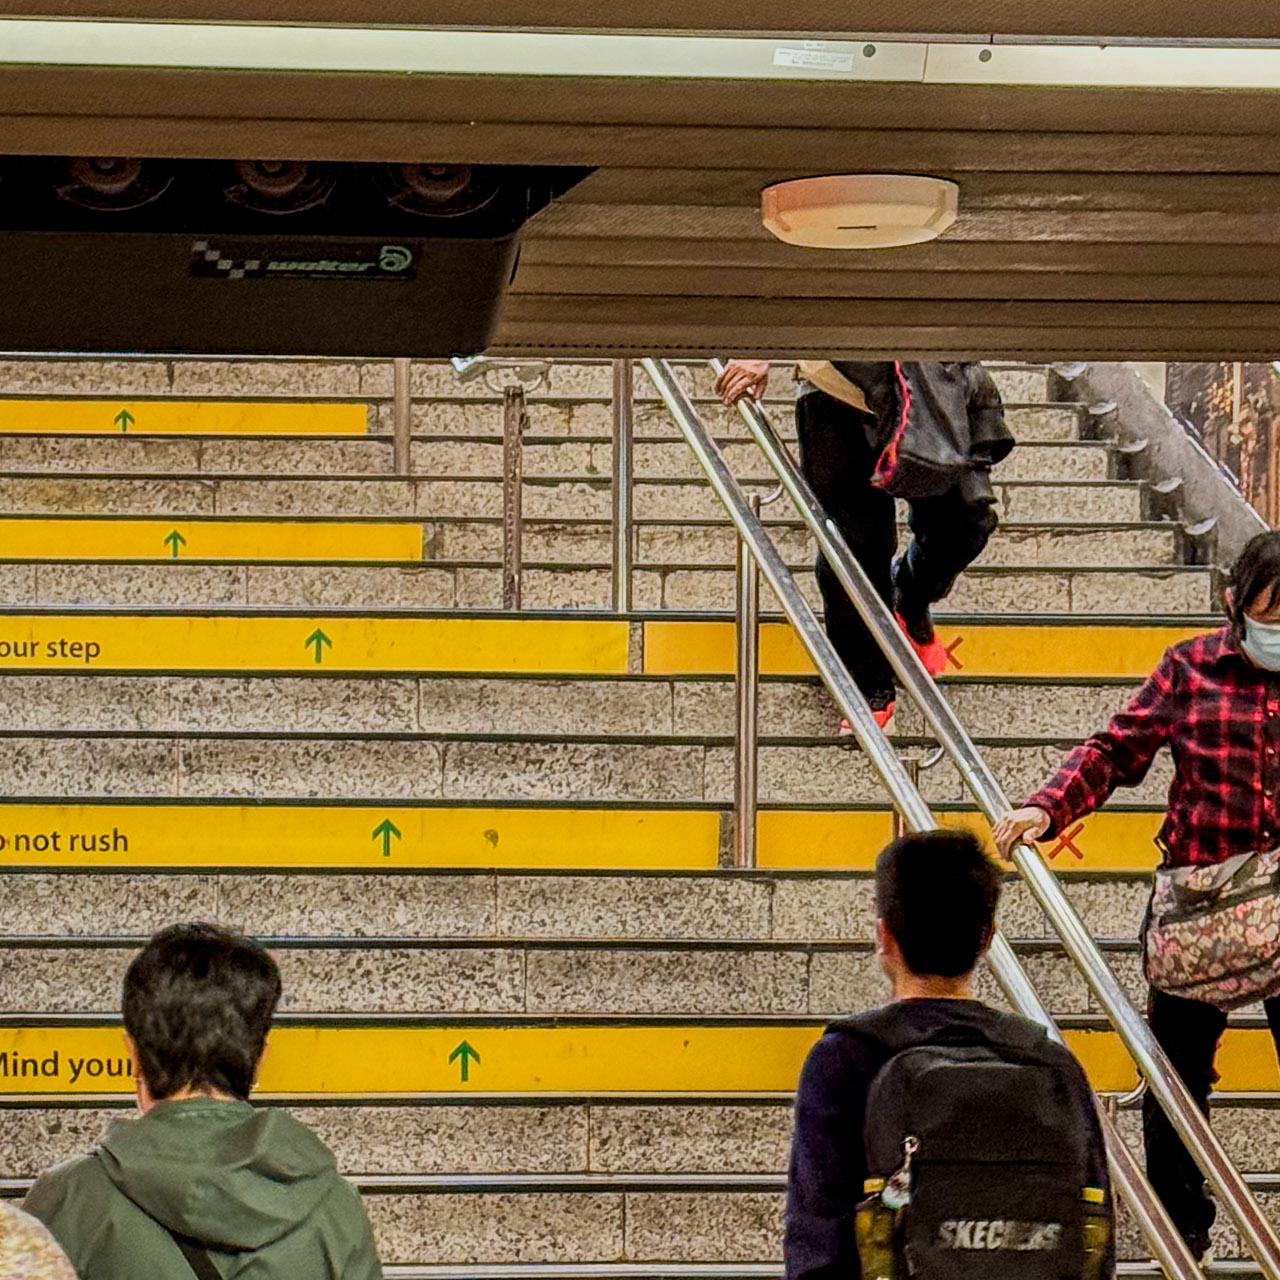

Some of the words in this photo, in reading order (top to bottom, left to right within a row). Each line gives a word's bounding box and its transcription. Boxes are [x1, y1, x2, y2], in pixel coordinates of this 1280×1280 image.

[46, 638, 100, 664] step
[14, 831, 61, 852] not
[69, 827, 128, 852] rush
